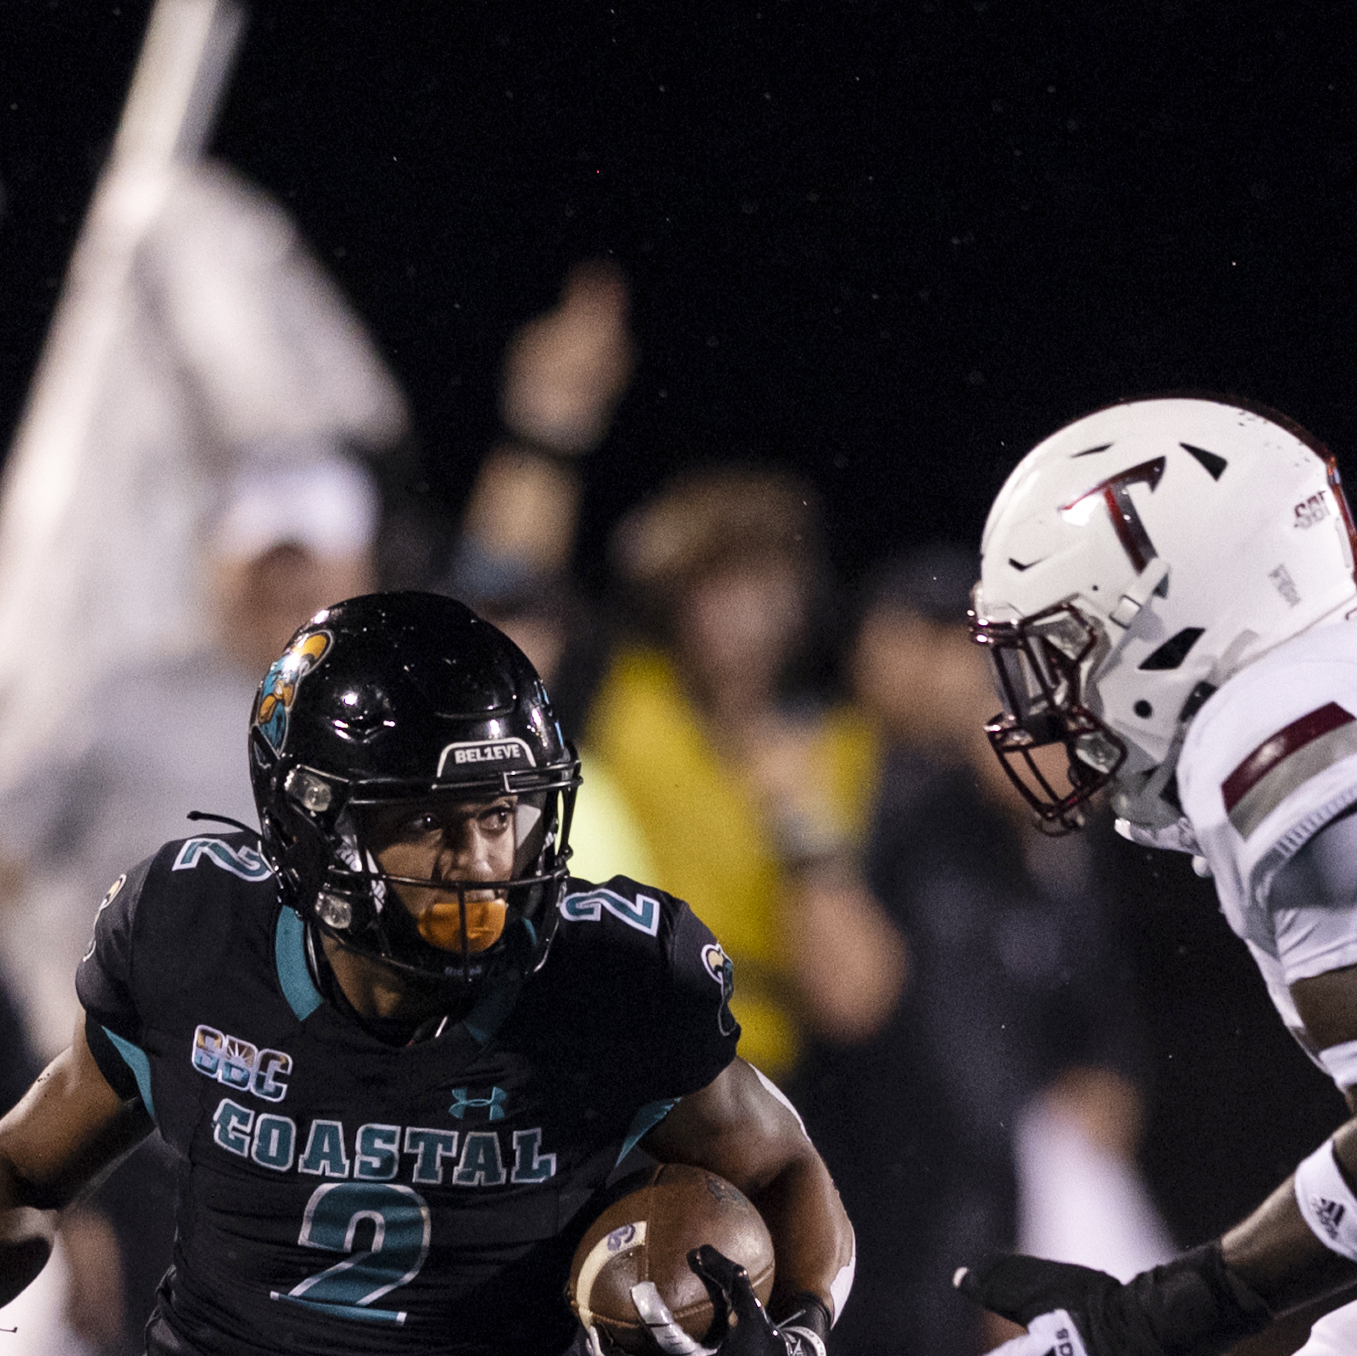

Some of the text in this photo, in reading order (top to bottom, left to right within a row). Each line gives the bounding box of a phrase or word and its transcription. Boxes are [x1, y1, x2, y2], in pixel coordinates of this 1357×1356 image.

[454, 743, 521, 764] BEL1EVE
[171, 838, 276, 881] 2
[560, 888, 660, 937] 2
[192, 1024, 293, 1102] SBC
[212, 1098, 557, 1186] COASTAL
[269, 1182, 432, 1326] 2
